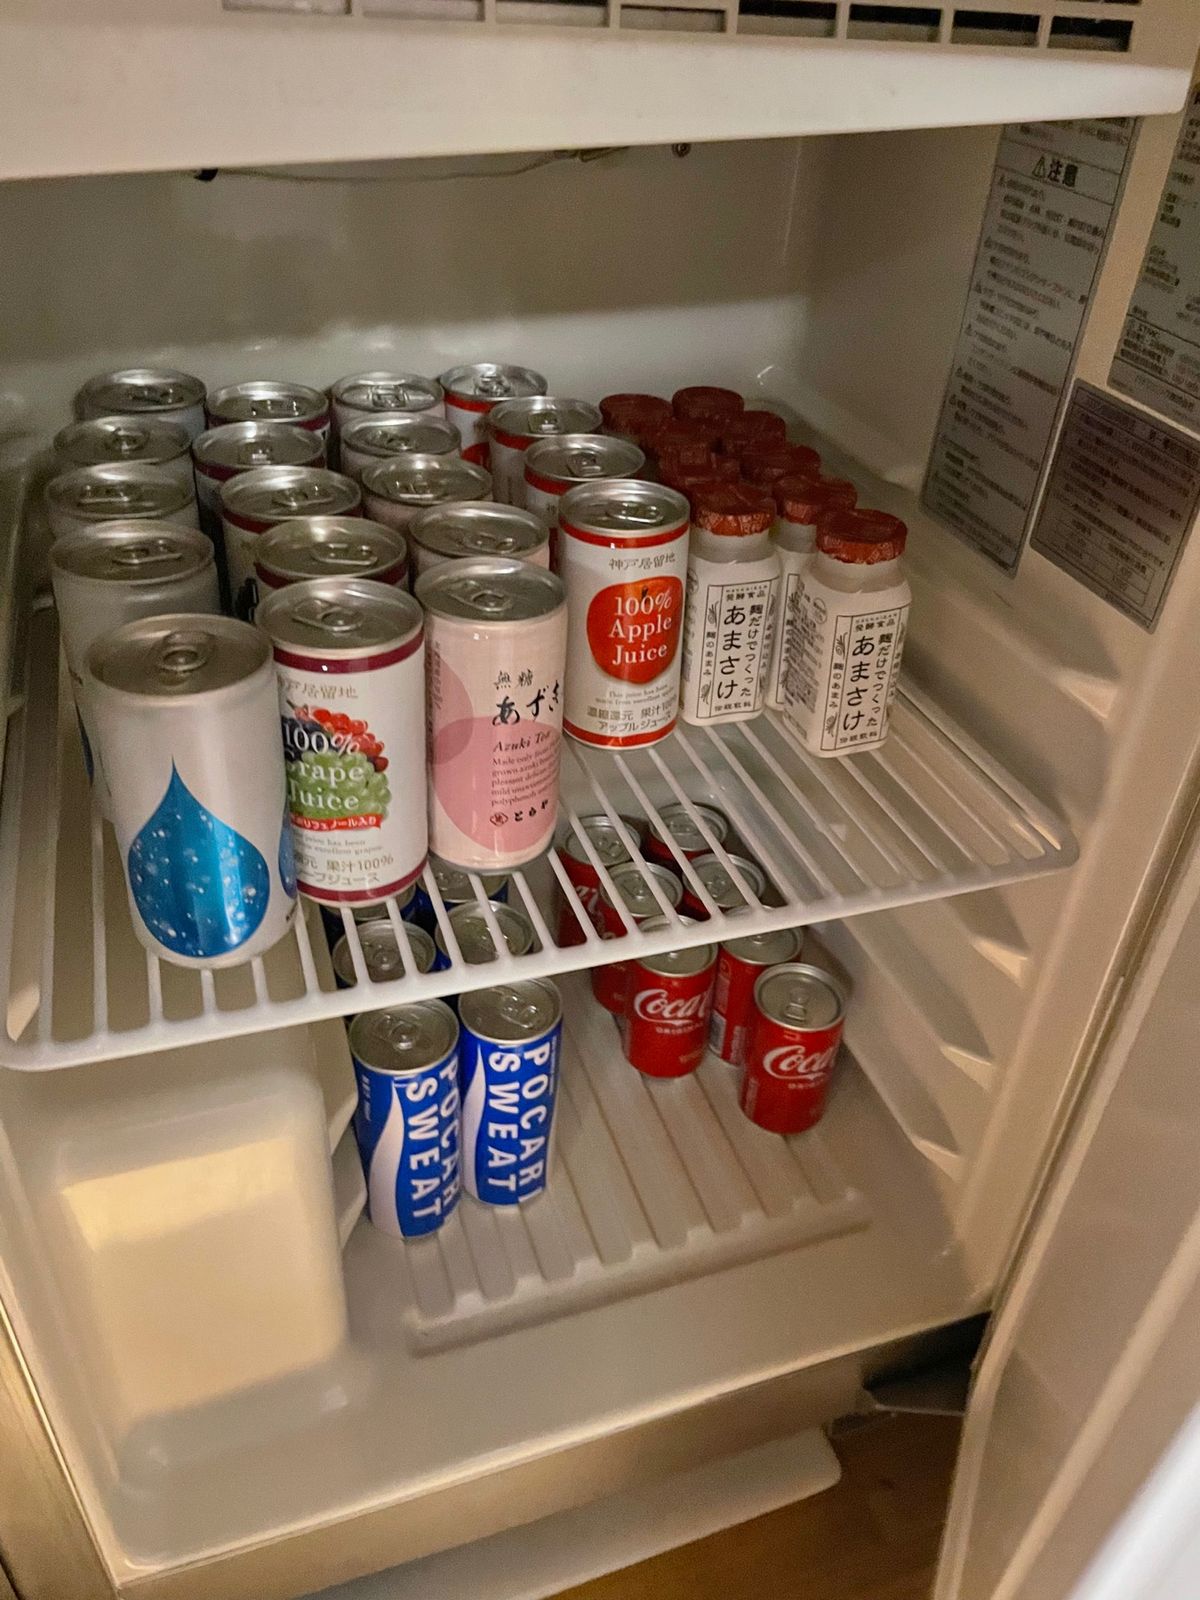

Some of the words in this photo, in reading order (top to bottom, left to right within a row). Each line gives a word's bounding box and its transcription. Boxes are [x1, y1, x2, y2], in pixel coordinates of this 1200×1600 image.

[609, 614, 672, 643] Apple
[614, 587, 672, 617] 100%
[612, 644, 667, 665] Juice
[717, 605, 746, 699] あまさけ
[843, 635, 875, 731] あまさけ
[492, 680, 560, 726] あずき
[492, 736, 531, 753] Azuki
[406, 1077, 442, 1217] SWEAT
[487, 1052, 521, 1191] SWEAT
[518, 1041, 550, 1202] POCARI
